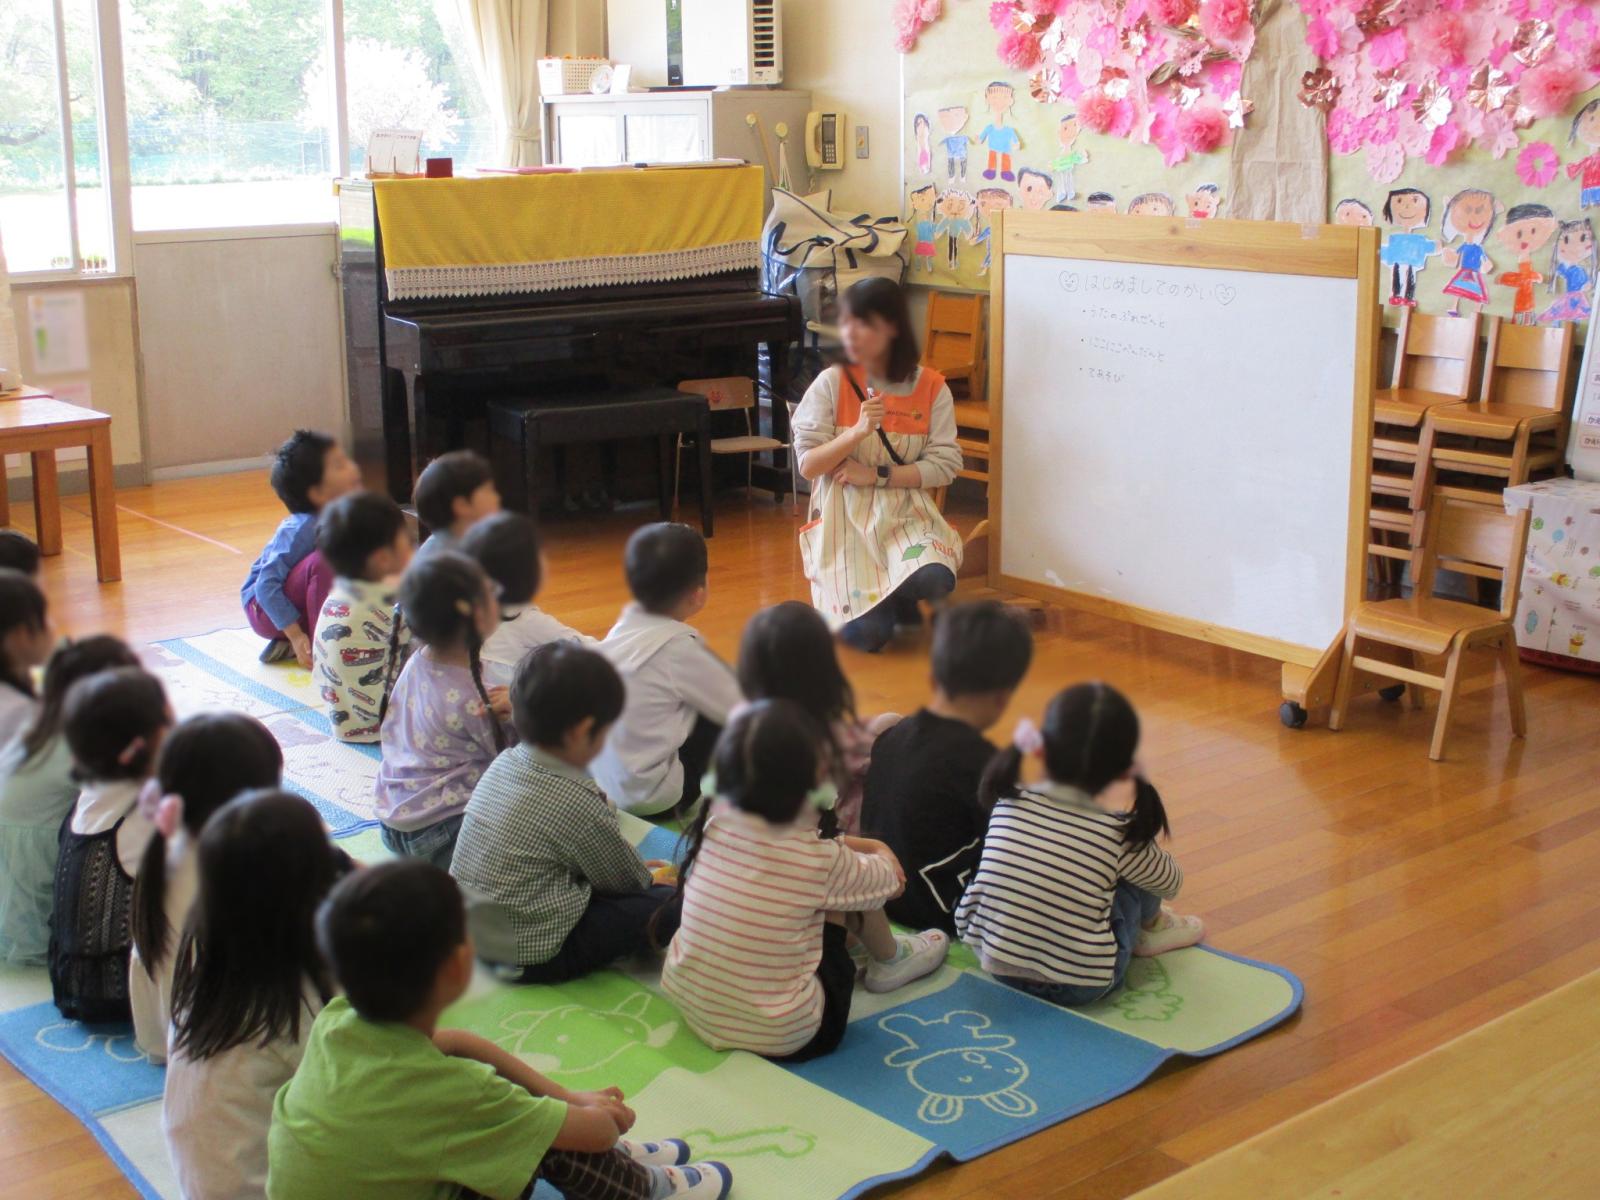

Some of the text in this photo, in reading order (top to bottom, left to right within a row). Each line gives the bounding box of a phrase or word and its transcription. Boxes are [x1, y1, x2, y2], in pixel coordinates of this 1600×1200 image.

[1084, 274, 1213, 300] はじめましてのかい
